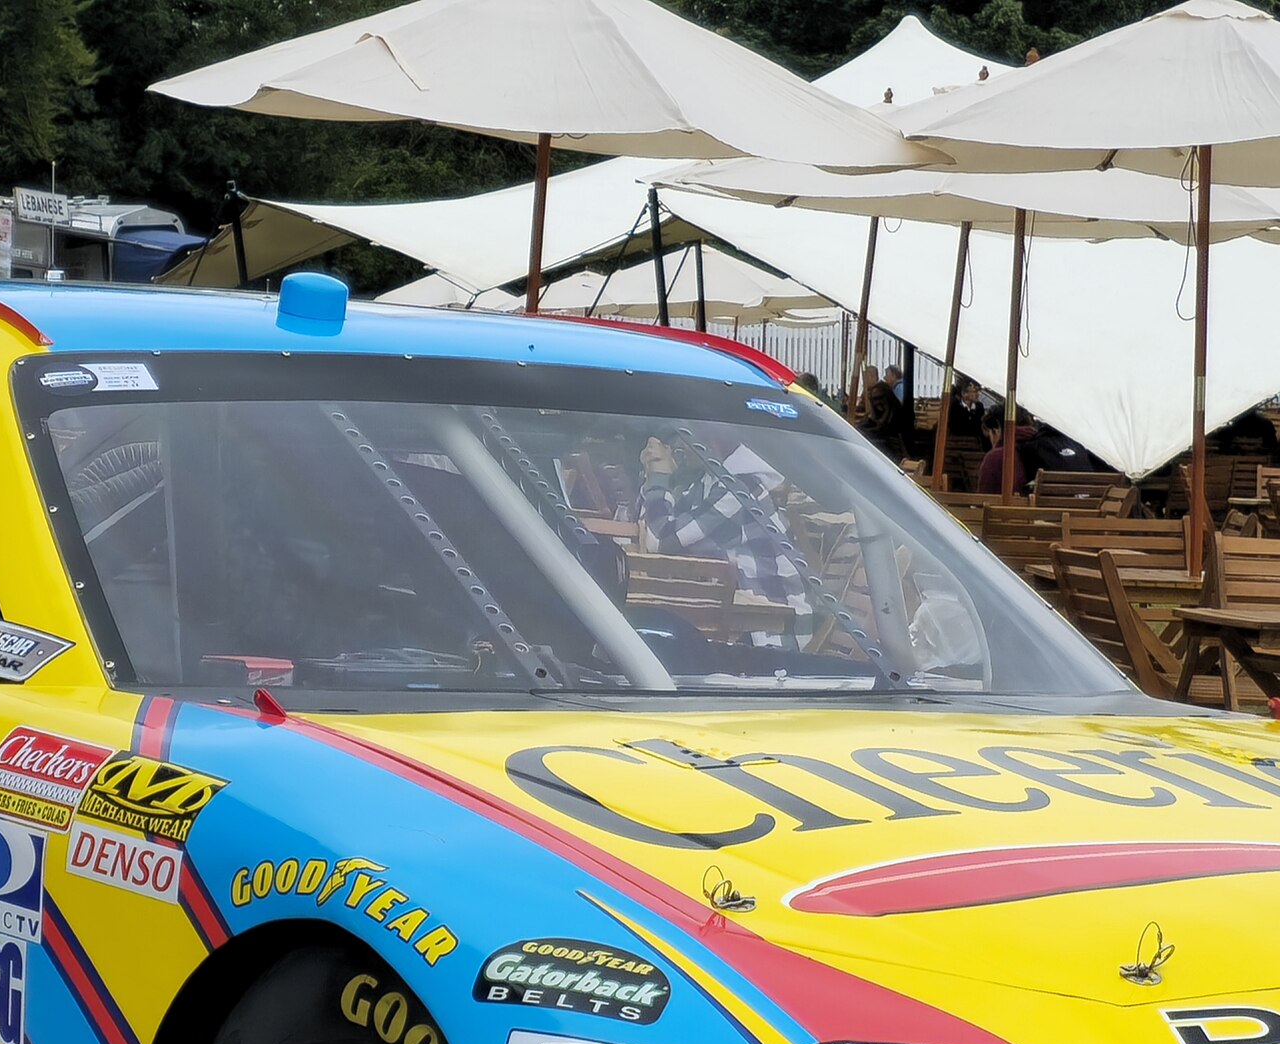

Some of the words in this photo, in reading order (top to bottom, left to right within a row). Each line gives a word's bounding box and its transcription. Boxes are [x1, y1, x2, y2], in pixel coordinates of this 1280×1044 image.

[21, 193, 64, 215] LEBANESE
[15, 799, 37, 815] FRIES
[41, 806, 66, 824] COLAS
[80, 789, 148, 831] MECHANIX
[148, 816, 192, 842] WEAR
[71, 831, 175, 892] DENSO
[231, 859, 459, 968] GOODYEAR
[486, 953, 666, 1006] Gatorback
[522, 941, 655, 976] GOODYEAR
[487, 985, 641, 1021] BELTS
